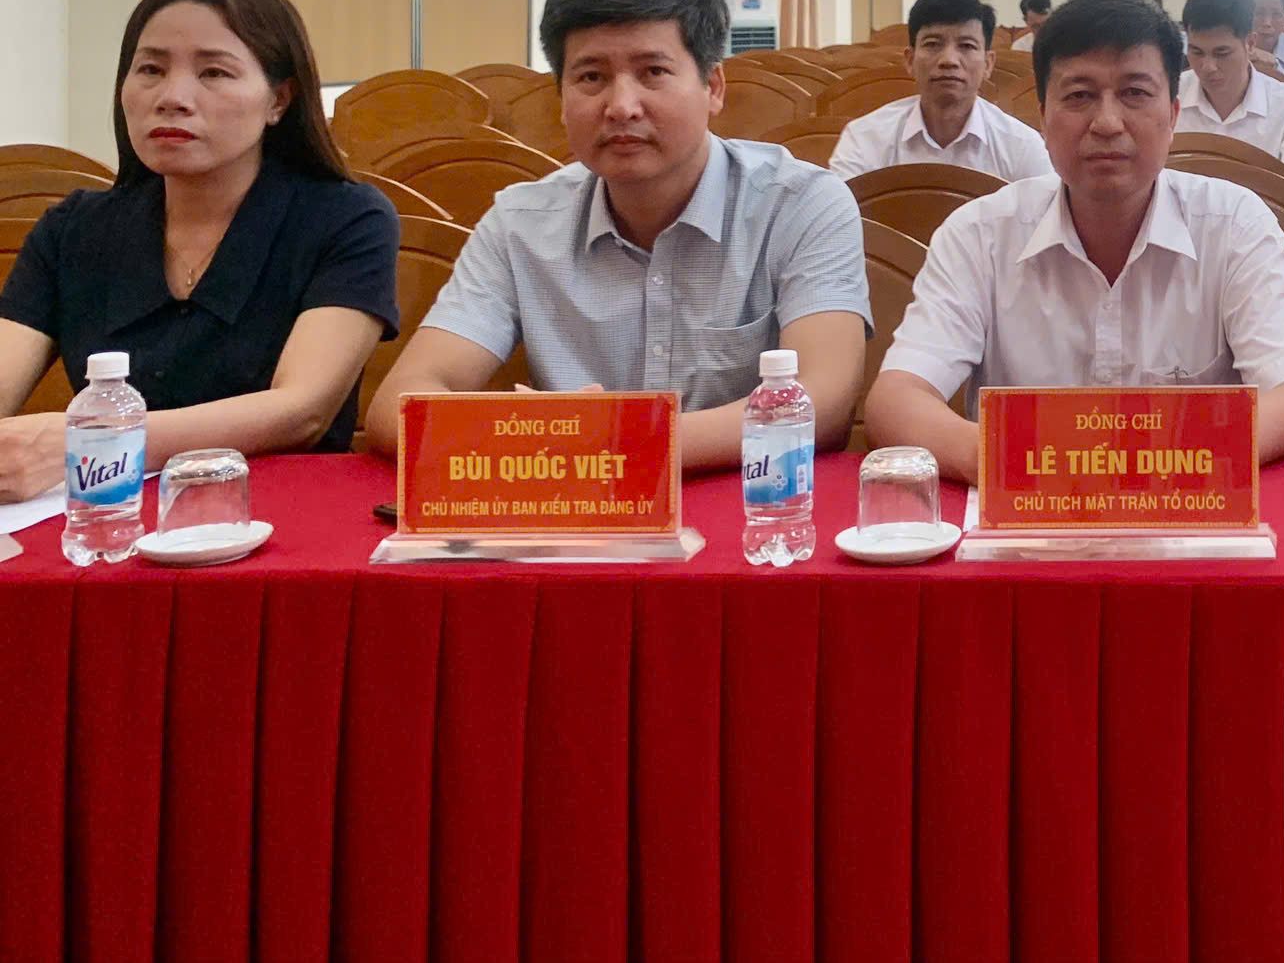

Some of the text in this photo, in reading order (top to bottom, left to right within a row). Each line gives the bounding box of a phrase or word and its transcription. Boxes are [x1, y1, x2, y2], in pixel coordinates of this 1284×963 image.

[494, 413, 580, 436] ĐỒNG CHÍ
[1075, 406, 1163, 430] ĐỒNG CHÍ
[75, 452, 128, 491] Vital
[449, 447, 627, 484] BÙI QUỐC VIỆT
[743, 454, 770, 482] ital
[1026, 442, 1213, 480] LÊ TIẾN DỤNG
[512, 501, 537, 515] BAN
[573, 500, 597, 515] TRA
[1014, 490, 1044, 511] CHỦ
[1048, 495, 1081, 513] TỊCH
[1184, 488, 1226, 511] QUỐC
